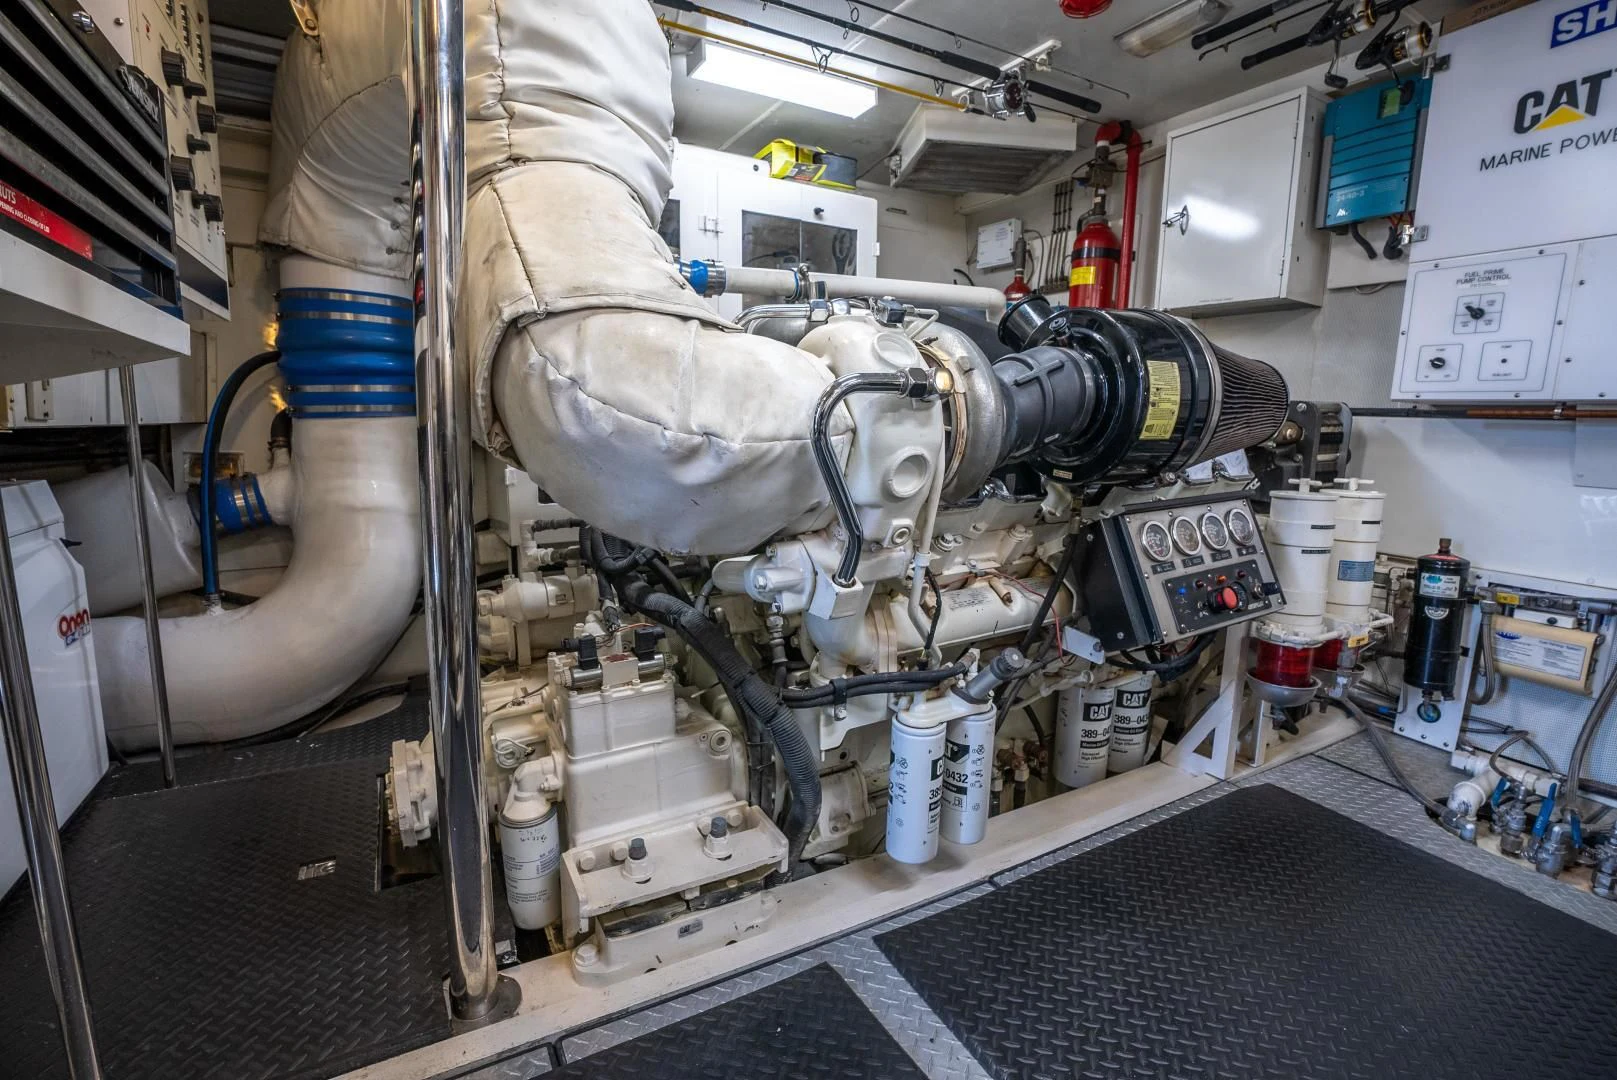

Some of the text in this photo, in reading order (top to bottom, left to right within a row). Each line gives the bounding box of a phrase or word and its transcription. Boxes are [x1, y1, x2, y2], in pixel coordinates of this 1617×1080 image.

[1513, 69, 1612, 135] CAT
[1479, 142, 1553, 172] MARINE
[1122, 692, 1146, 706] CAT
[1089, 705, 1110, 720] CAT
